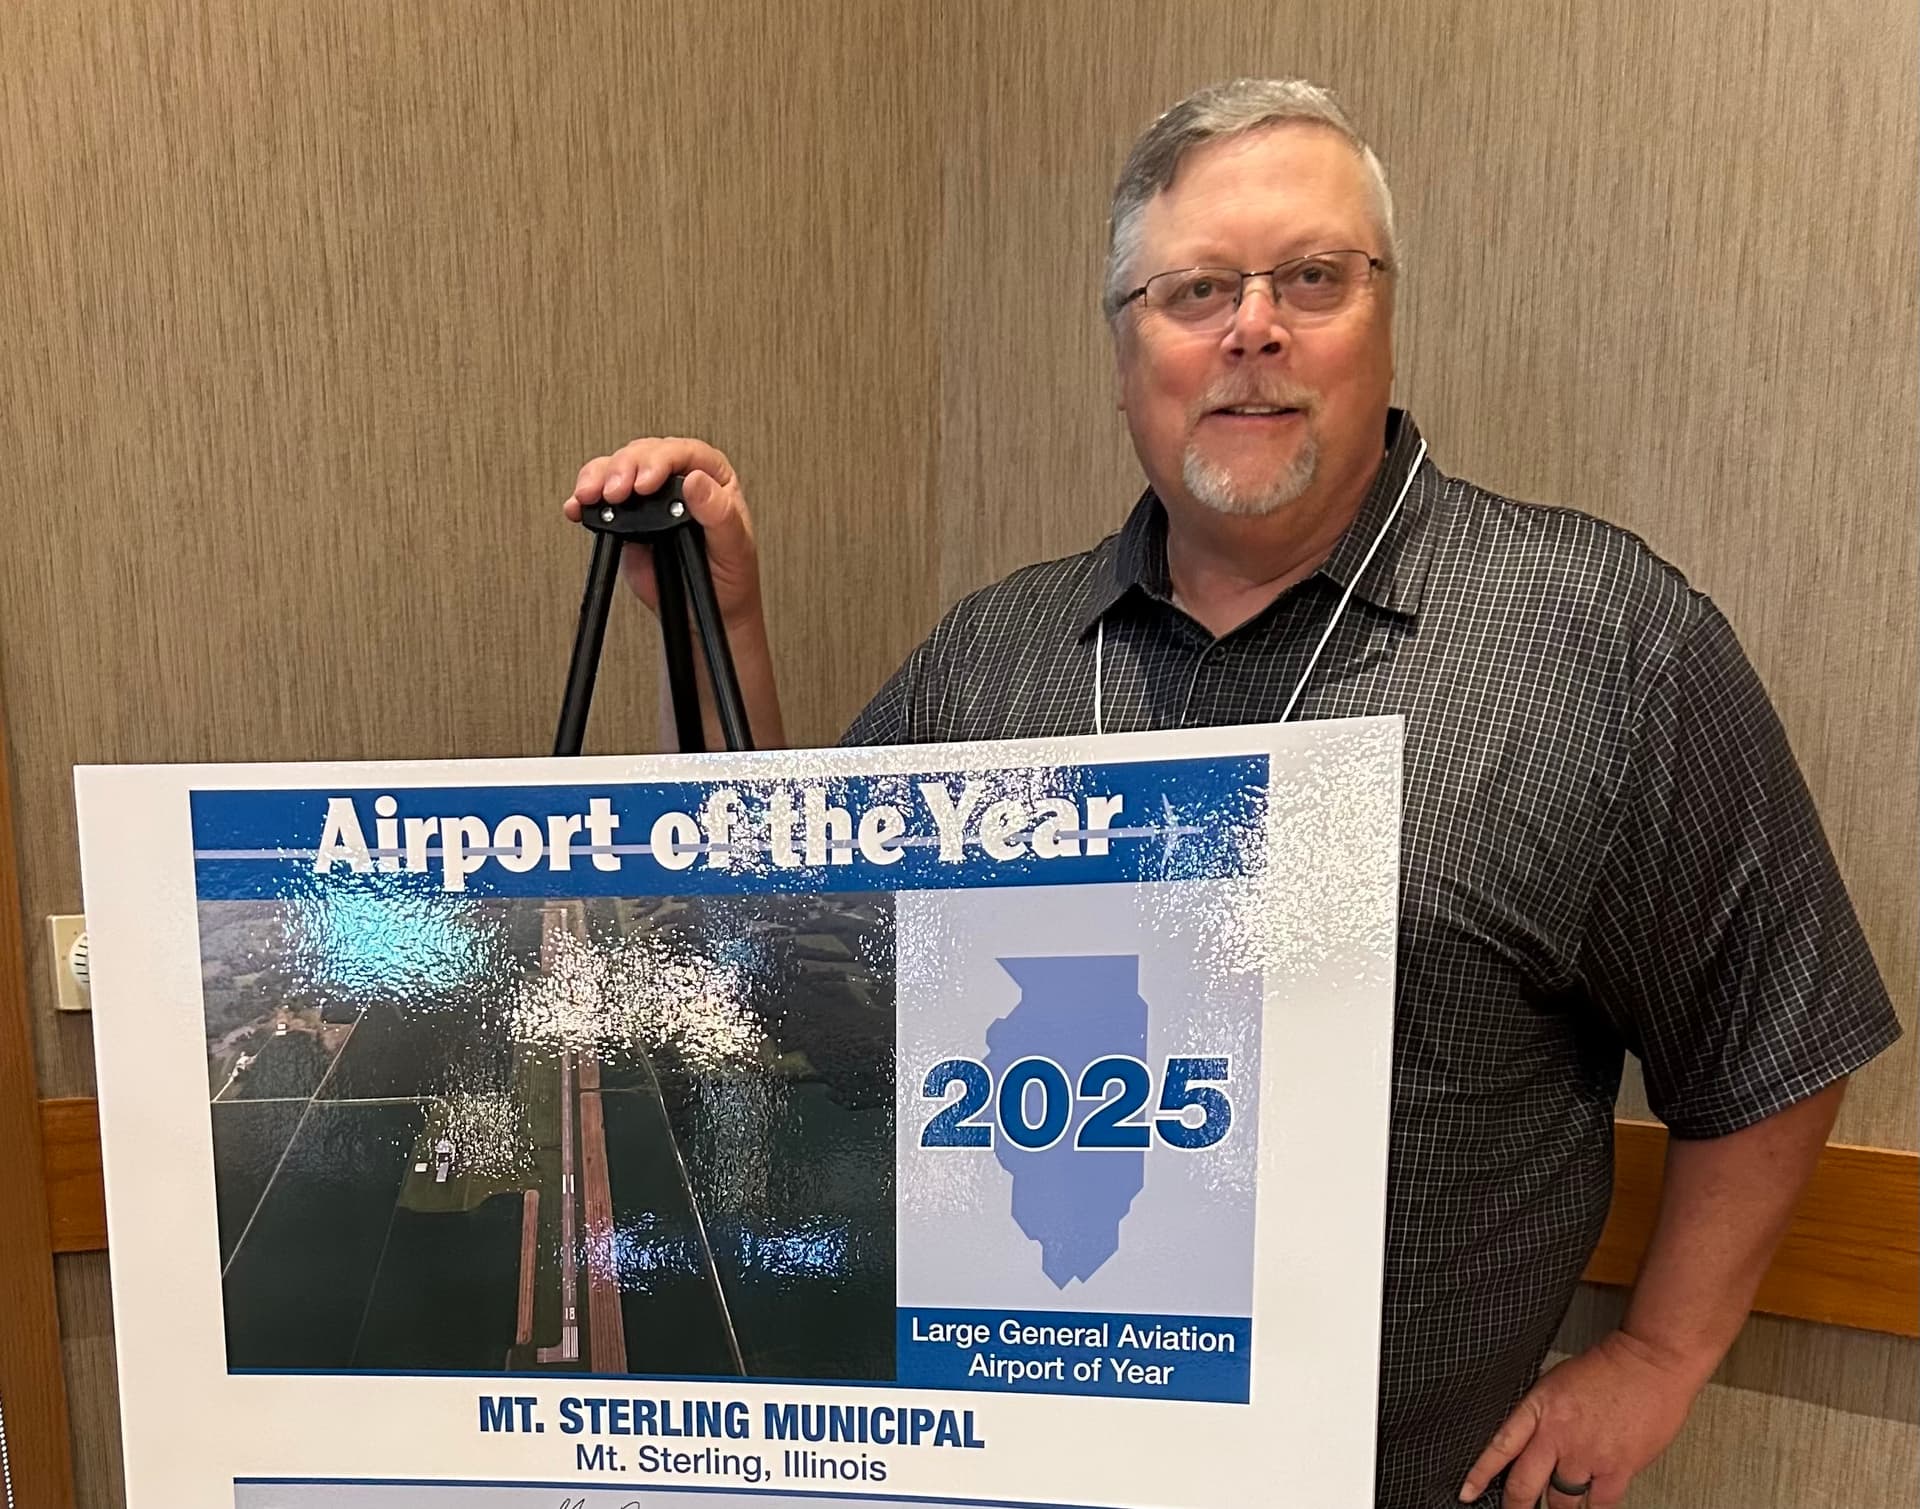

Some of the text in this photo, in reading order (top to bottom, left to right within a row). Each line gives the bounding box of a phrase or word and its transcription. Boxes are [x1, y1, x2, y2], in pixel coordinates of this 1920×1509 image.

[313, 781, 1125, 892] Airport of the Year
[917, 1055, 1234, 1152] 2025
[565, 1307, 576, 1320] 18
[912, 1317, 1235, 1352] Large General Aviation
[968, 1353, 1175, 1385] Airport of Year
[479, 1397, 985, 1448] MT. STERLING MUNICIPAL
[576, 1444, 887, 1482] Mt. Sterling, Illinois
